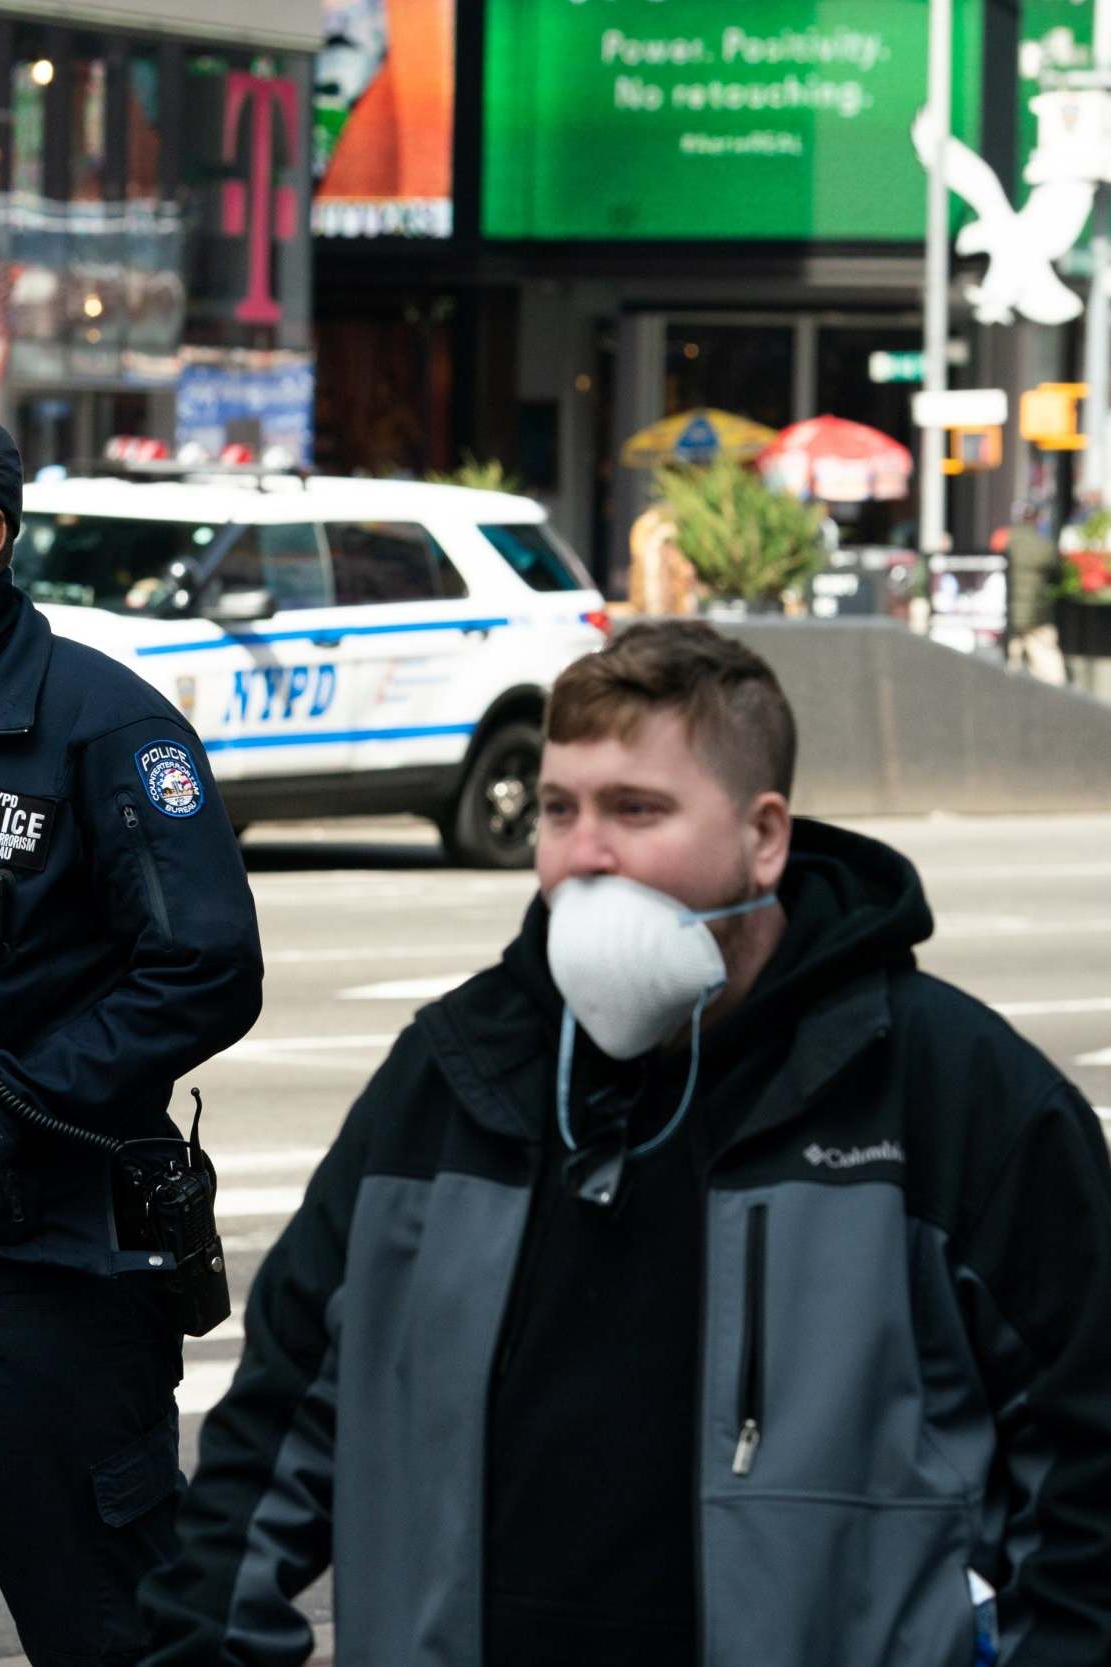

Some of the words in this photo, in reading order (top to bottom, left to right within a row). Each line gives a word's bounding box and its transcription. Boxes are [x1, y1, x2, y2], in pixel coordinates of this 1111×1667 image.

[600, 28, 715, 66] Power.
[721, 25, 892, 72] Positivity.
[614, 74, 664, 111] No
[671, 73, 874, 118] retouching.
[223, 664, 336, 723] NYPD
[141, 747, 191, 772] POLICE
[165, 801, 197, 813] BUREAU
